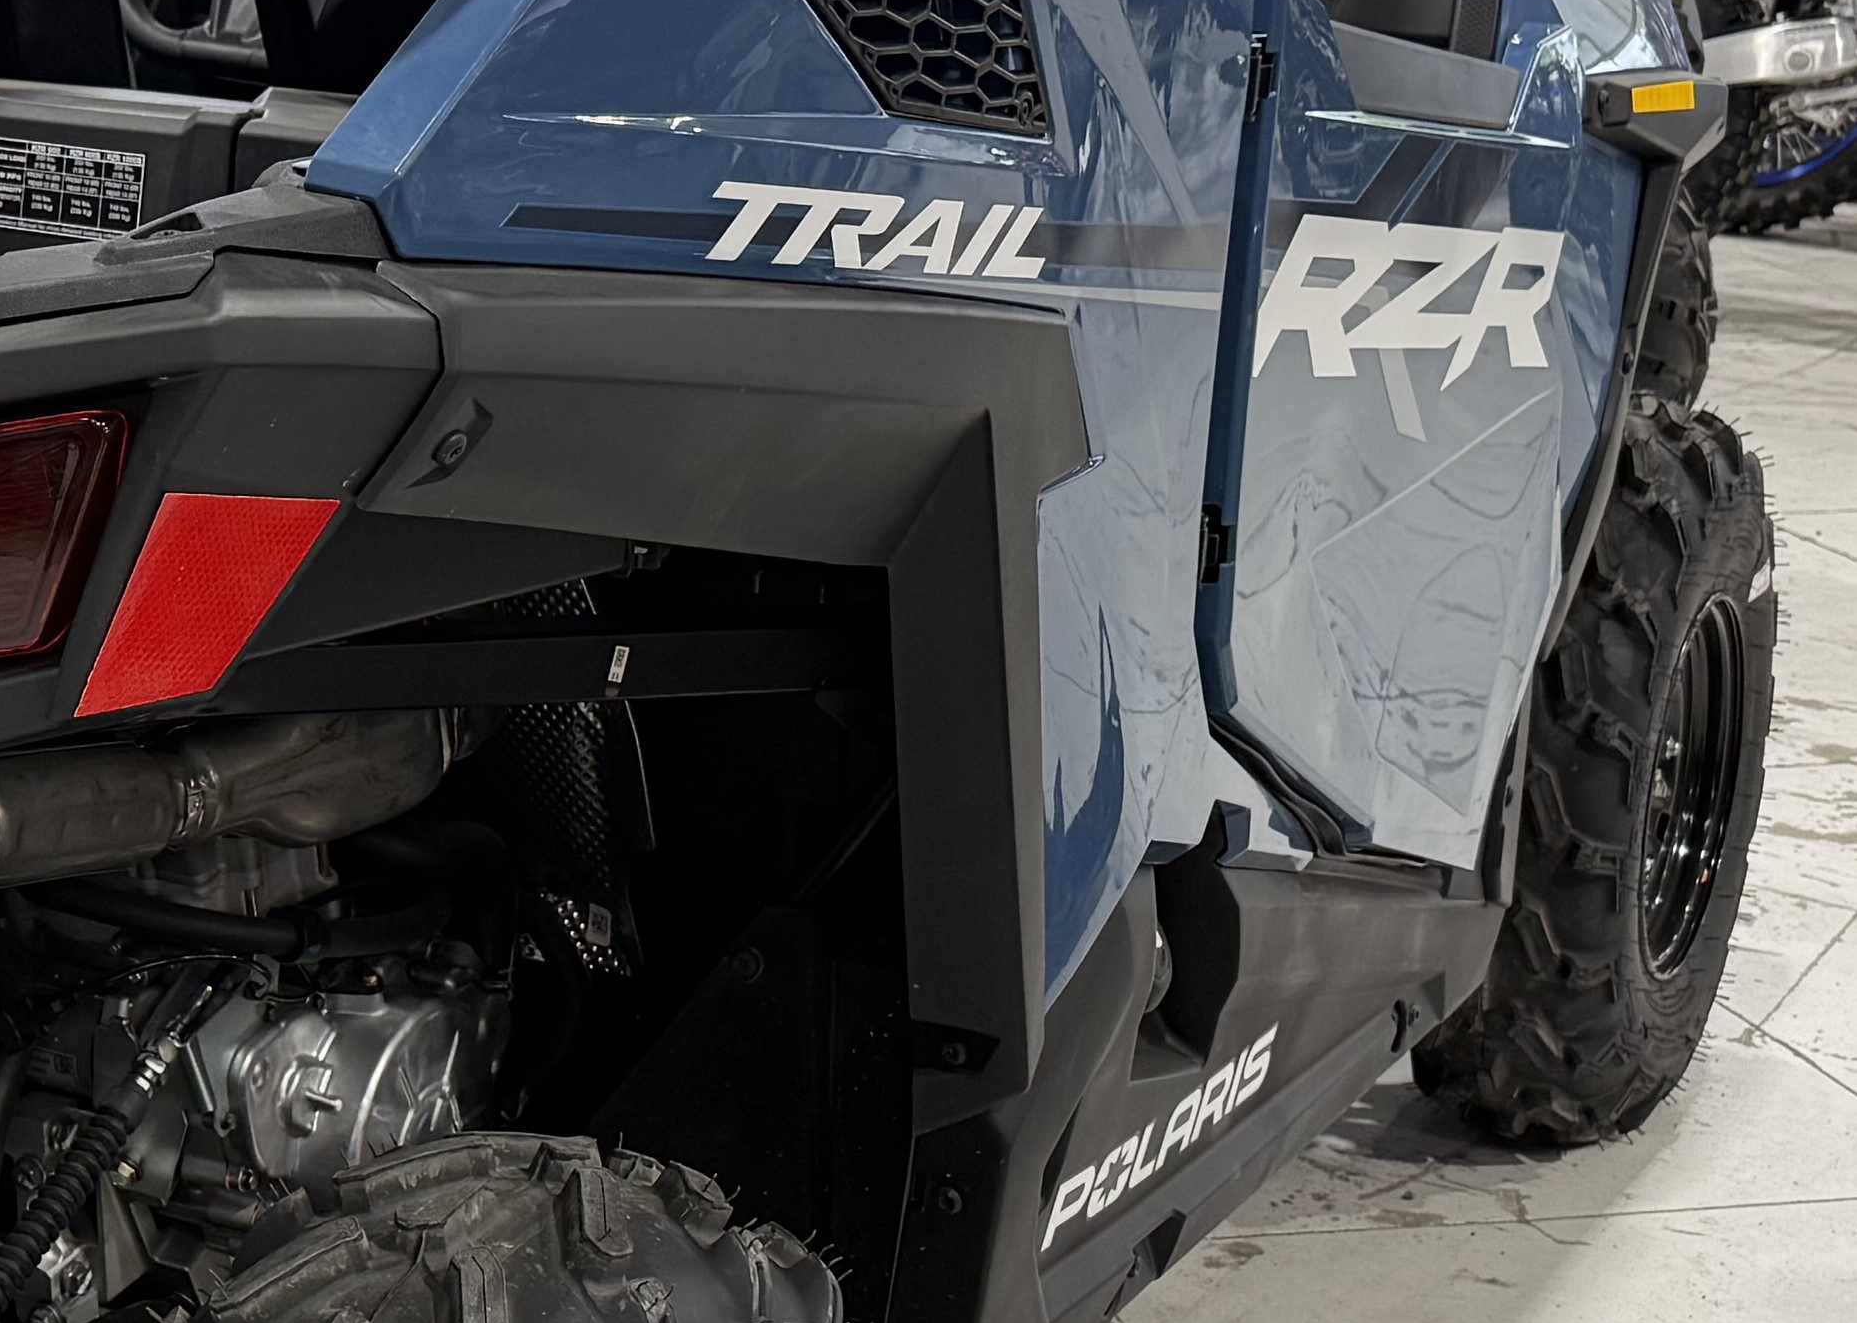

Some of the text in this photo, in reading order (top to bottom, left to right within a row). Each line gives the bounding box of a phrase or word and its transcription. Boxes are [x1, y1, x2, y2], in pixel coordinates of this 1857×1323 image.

[704, 180, 1047, 279] TRAIL
[1252, 213, 1565, 392] RZR
[1040, 1020, 1280, 1253] POLARIS
